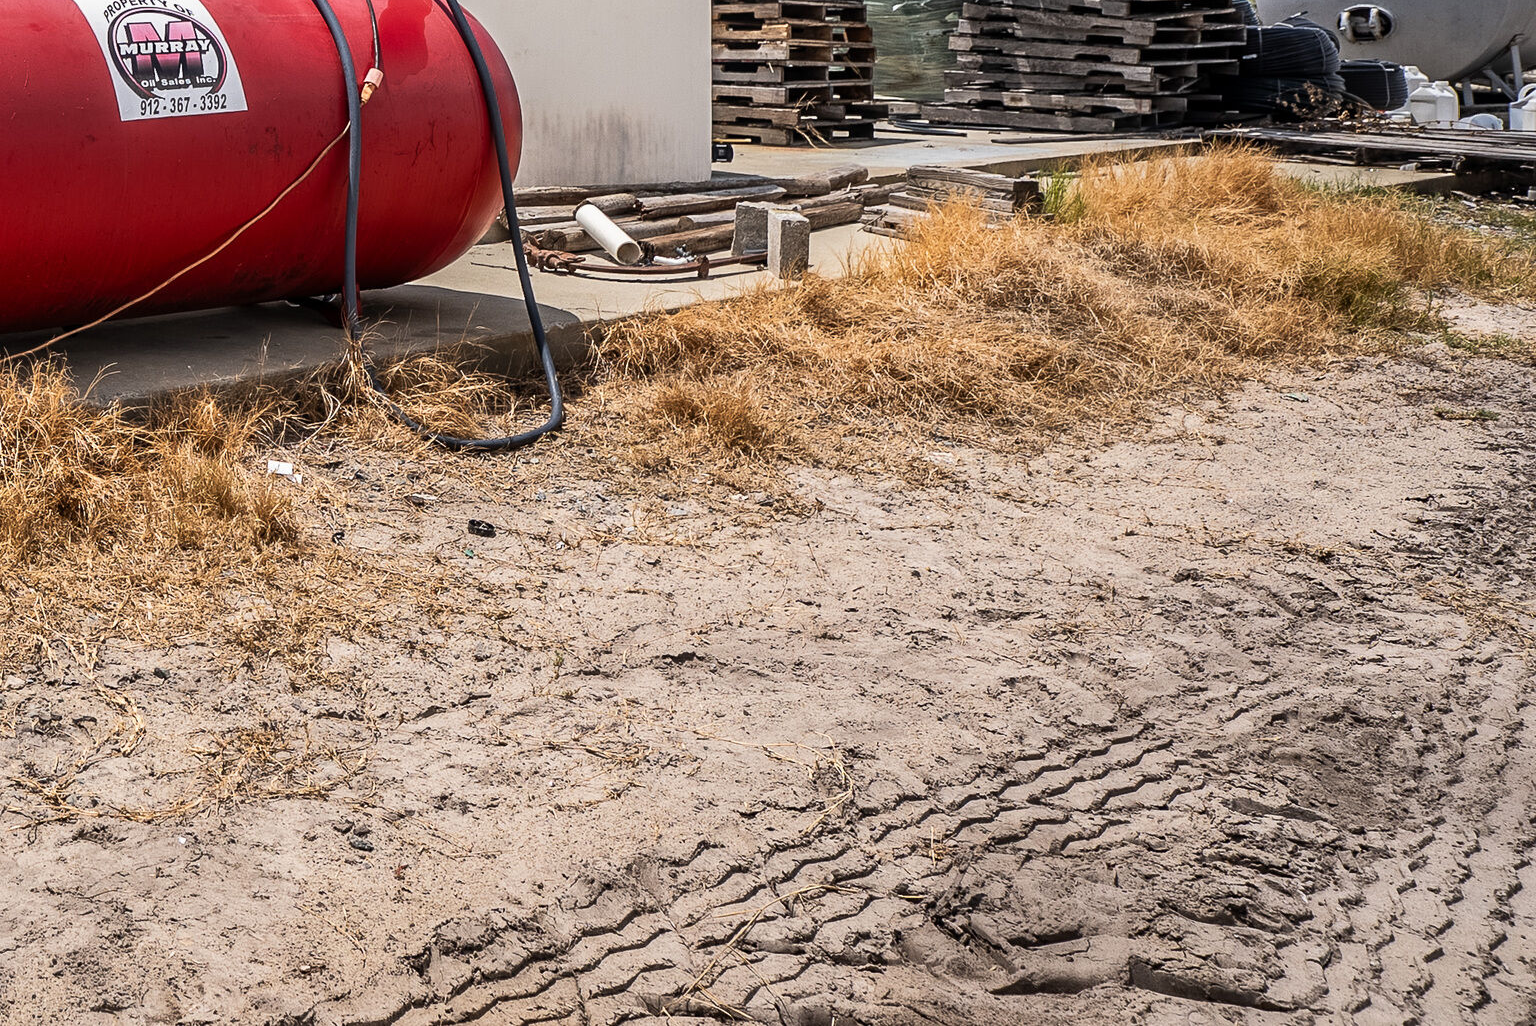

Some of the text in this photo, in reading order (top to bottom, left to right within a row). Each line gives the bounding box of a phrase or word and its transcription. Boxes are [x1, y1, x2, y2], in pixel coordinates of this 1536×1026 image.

[119, 39, 211, 56] MURRAY
[140, 75, 217, 88] Oil Sales Inc.
